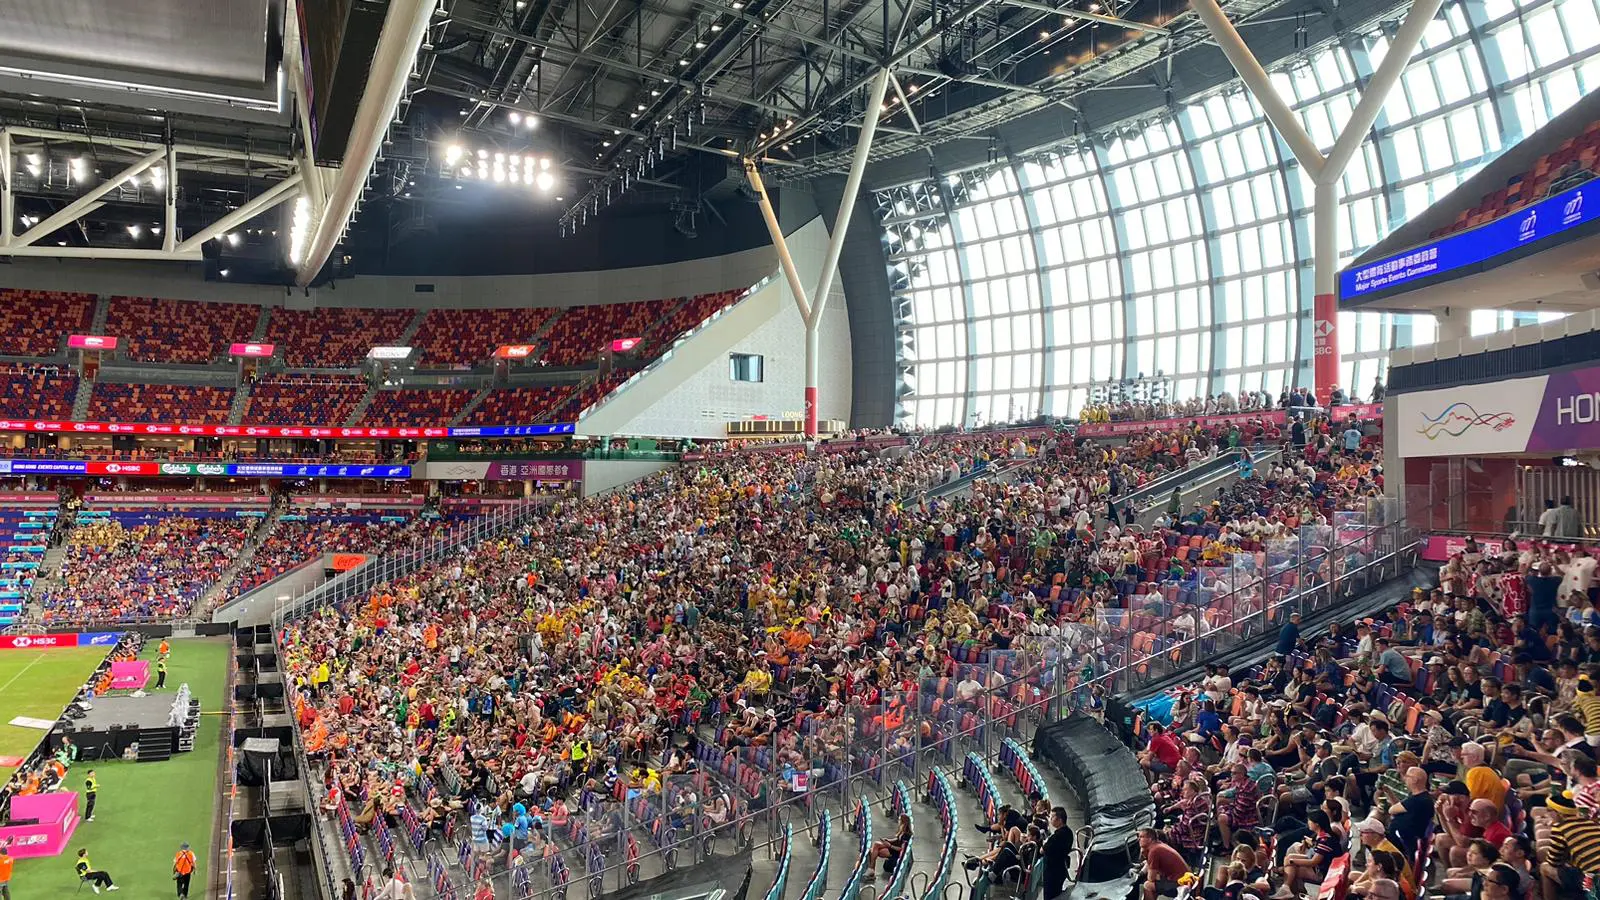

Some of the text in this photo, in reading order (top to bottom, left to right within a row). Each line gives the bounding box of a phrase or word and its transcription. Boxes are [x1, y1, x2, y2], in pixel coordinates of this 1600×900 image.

[1355, 263, 1437, 291] Major Sports Events Committee
